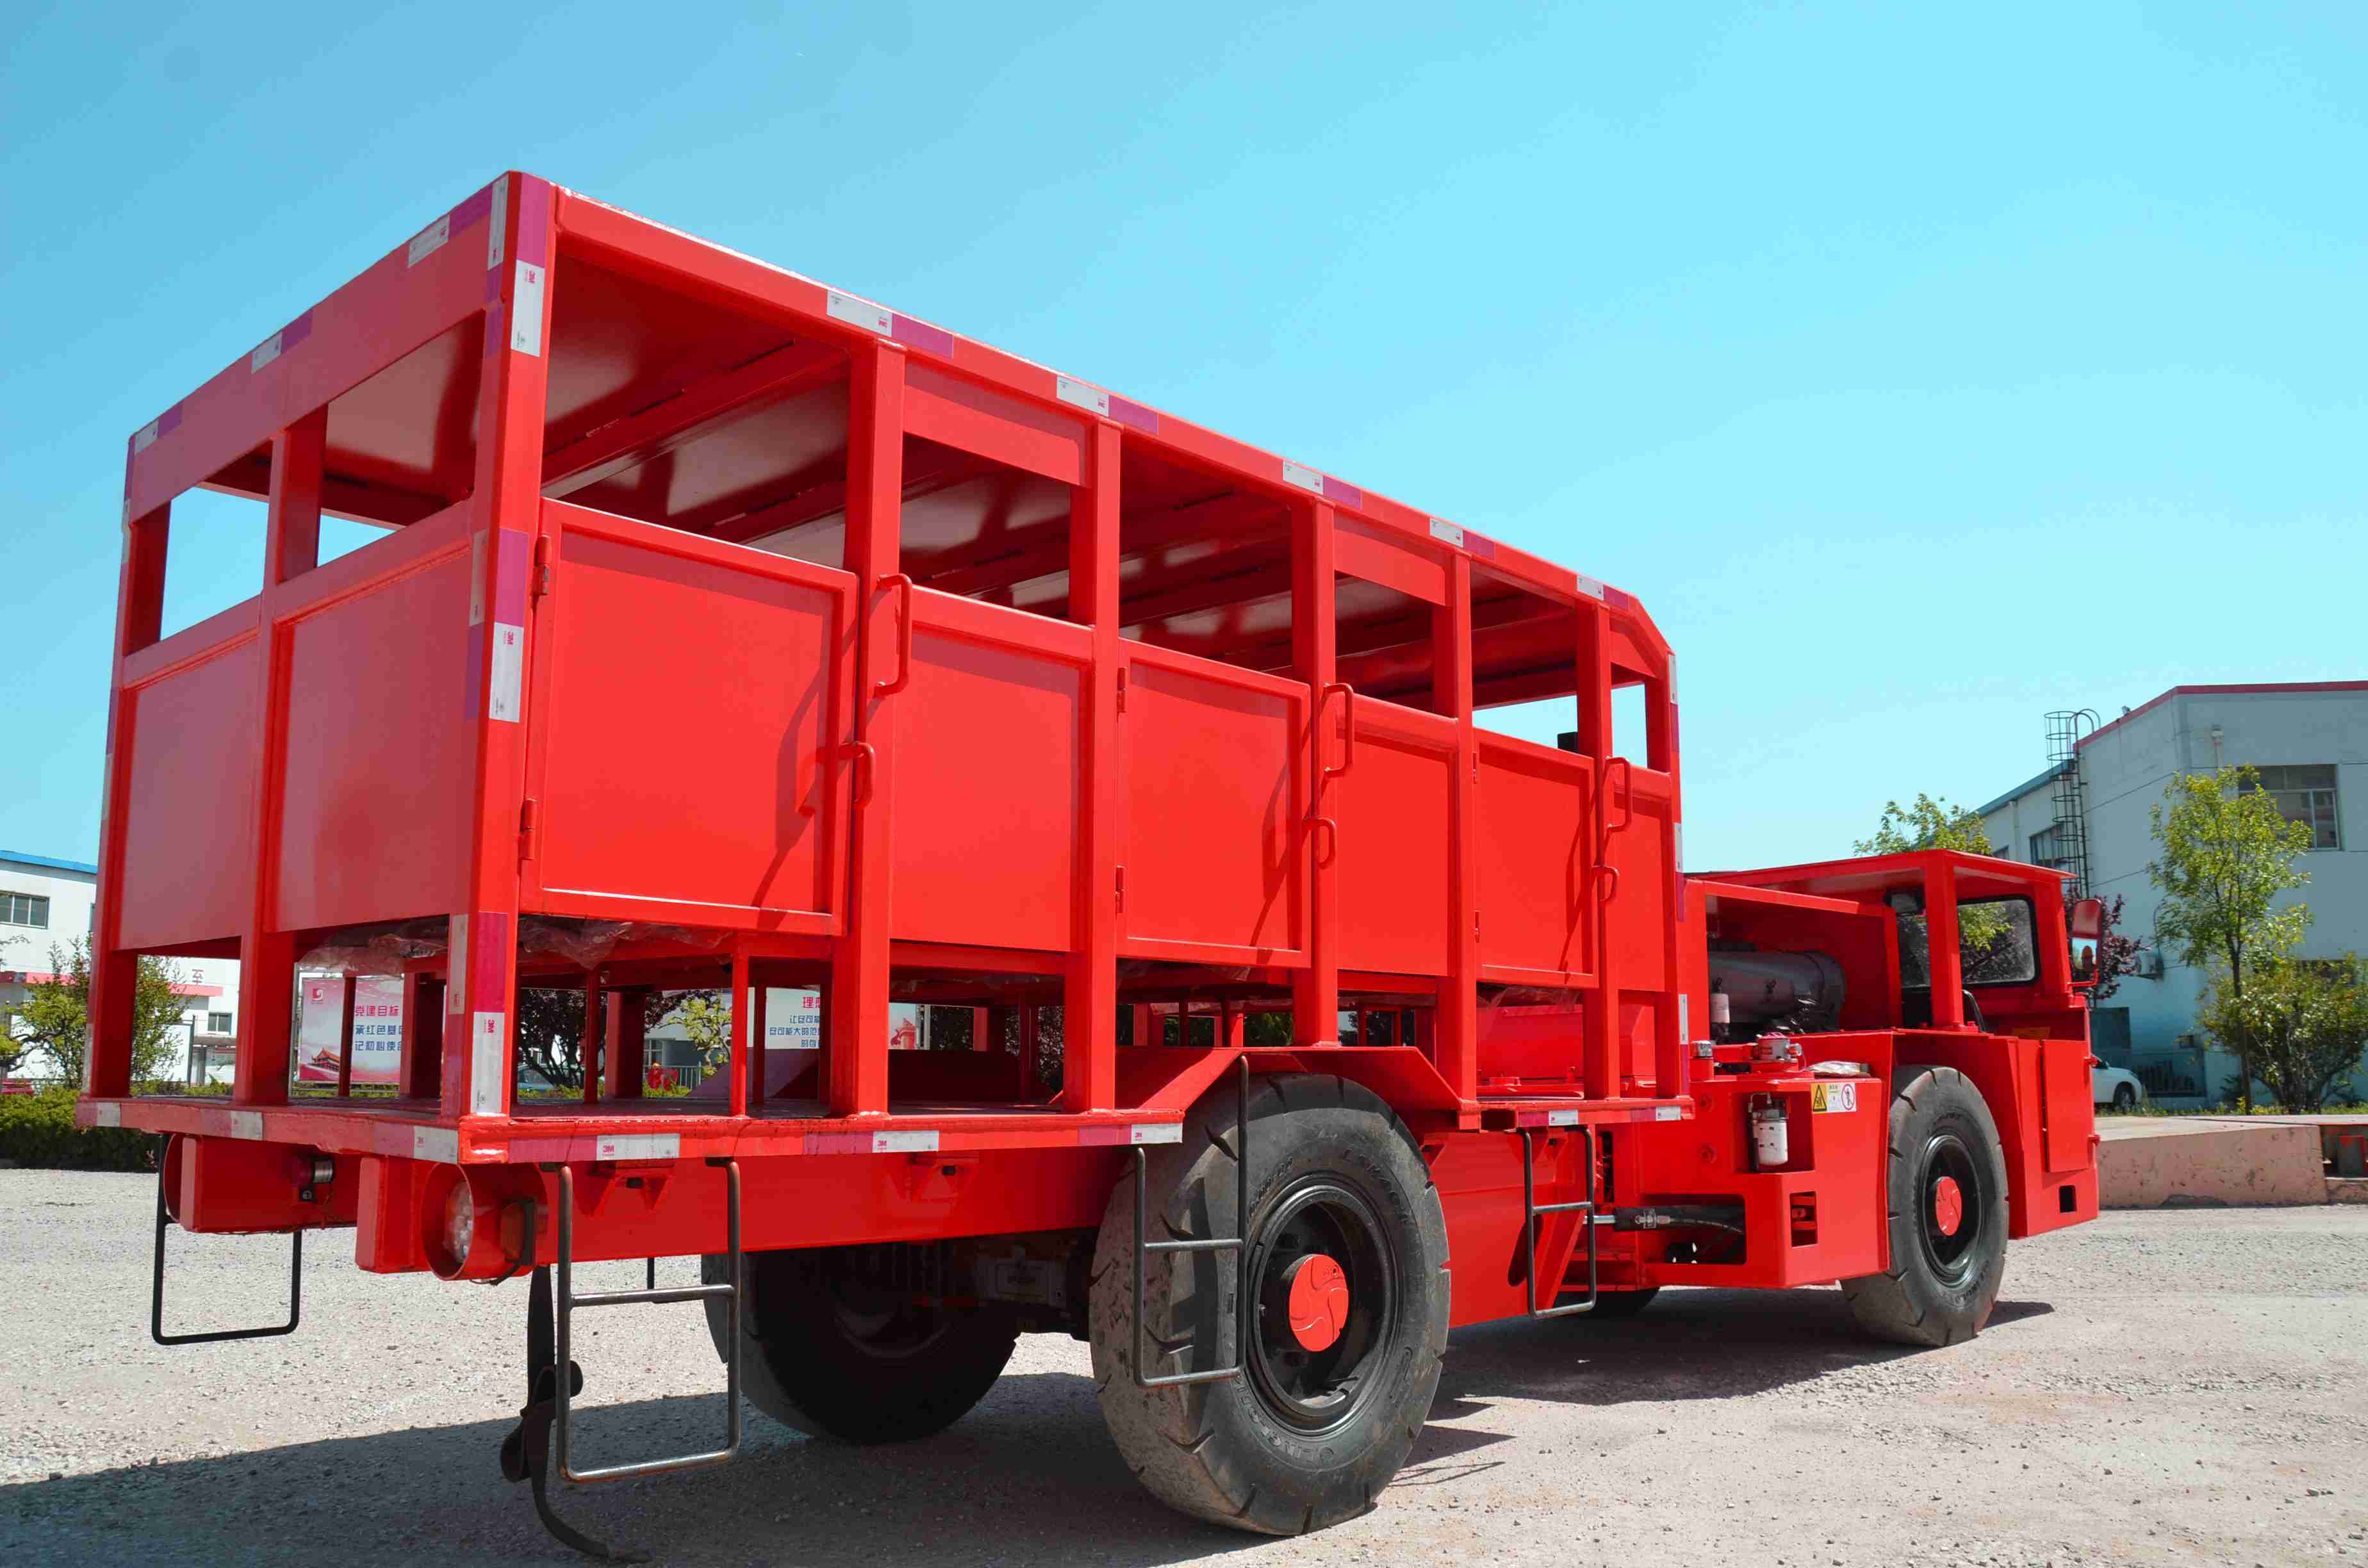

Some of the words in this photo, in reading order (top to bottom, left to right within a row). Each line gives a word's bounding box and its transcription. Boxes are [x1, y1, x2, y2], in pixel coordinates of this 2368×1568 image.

[488, 1019, 495, 1034] 3M
[769, 1027, 820, 1035] 尽可能大的范
[603, 1145, 615, 1154] 3M
